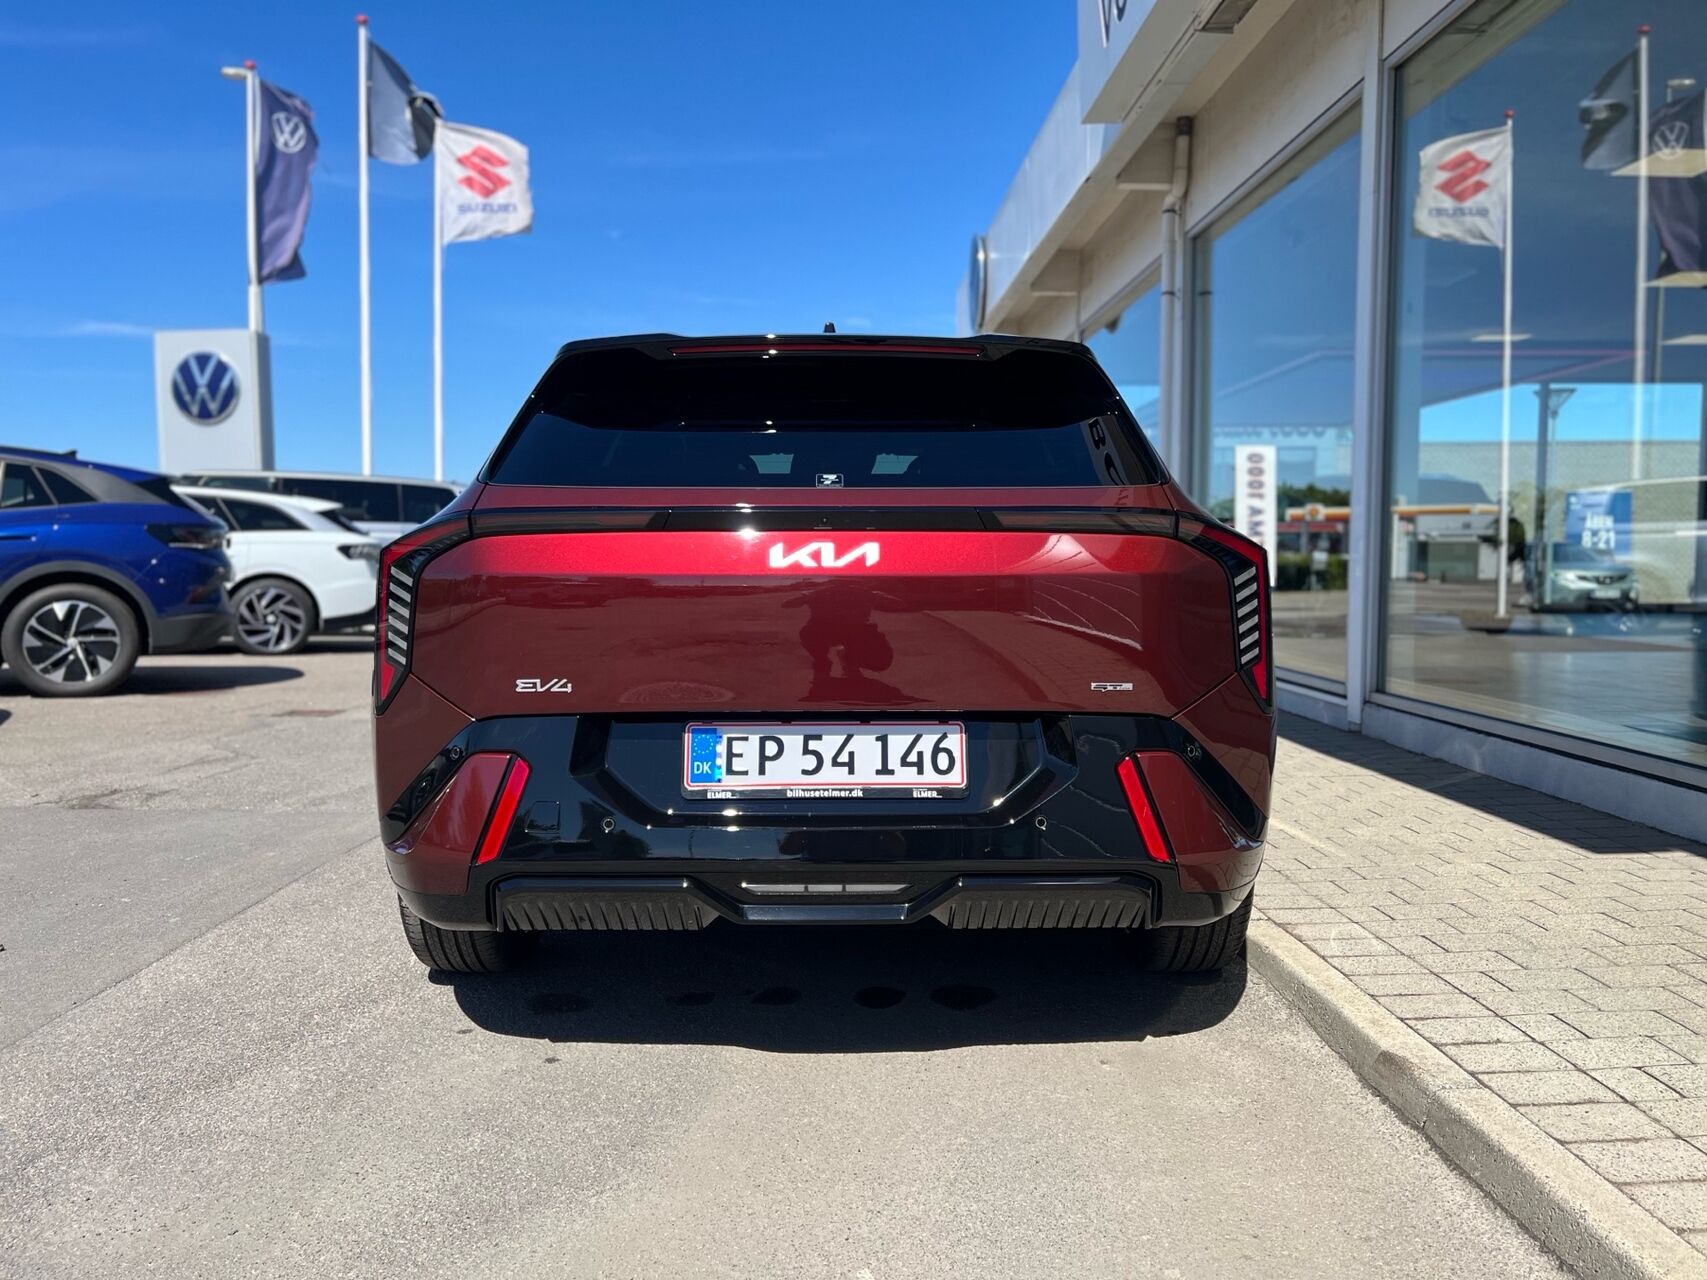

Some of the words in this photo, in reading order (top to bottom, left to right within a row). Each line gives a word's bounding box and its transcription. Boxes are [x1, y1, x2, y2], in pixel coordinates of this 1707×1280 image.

[768, 541, 881, 569] KIA
[515, 678, 573, 693] EV4
[725, 735, 785, 776] EP
[800, 733, 855, 776] 54
[874, 732, 956, 776] 146
[693, 761, 713, 775] DK
[707, 791, 732, 799] ELMER
[786, 788, 864, 798] bilhusetelmer.dk
[912, 790, 937, 798] ELMER
